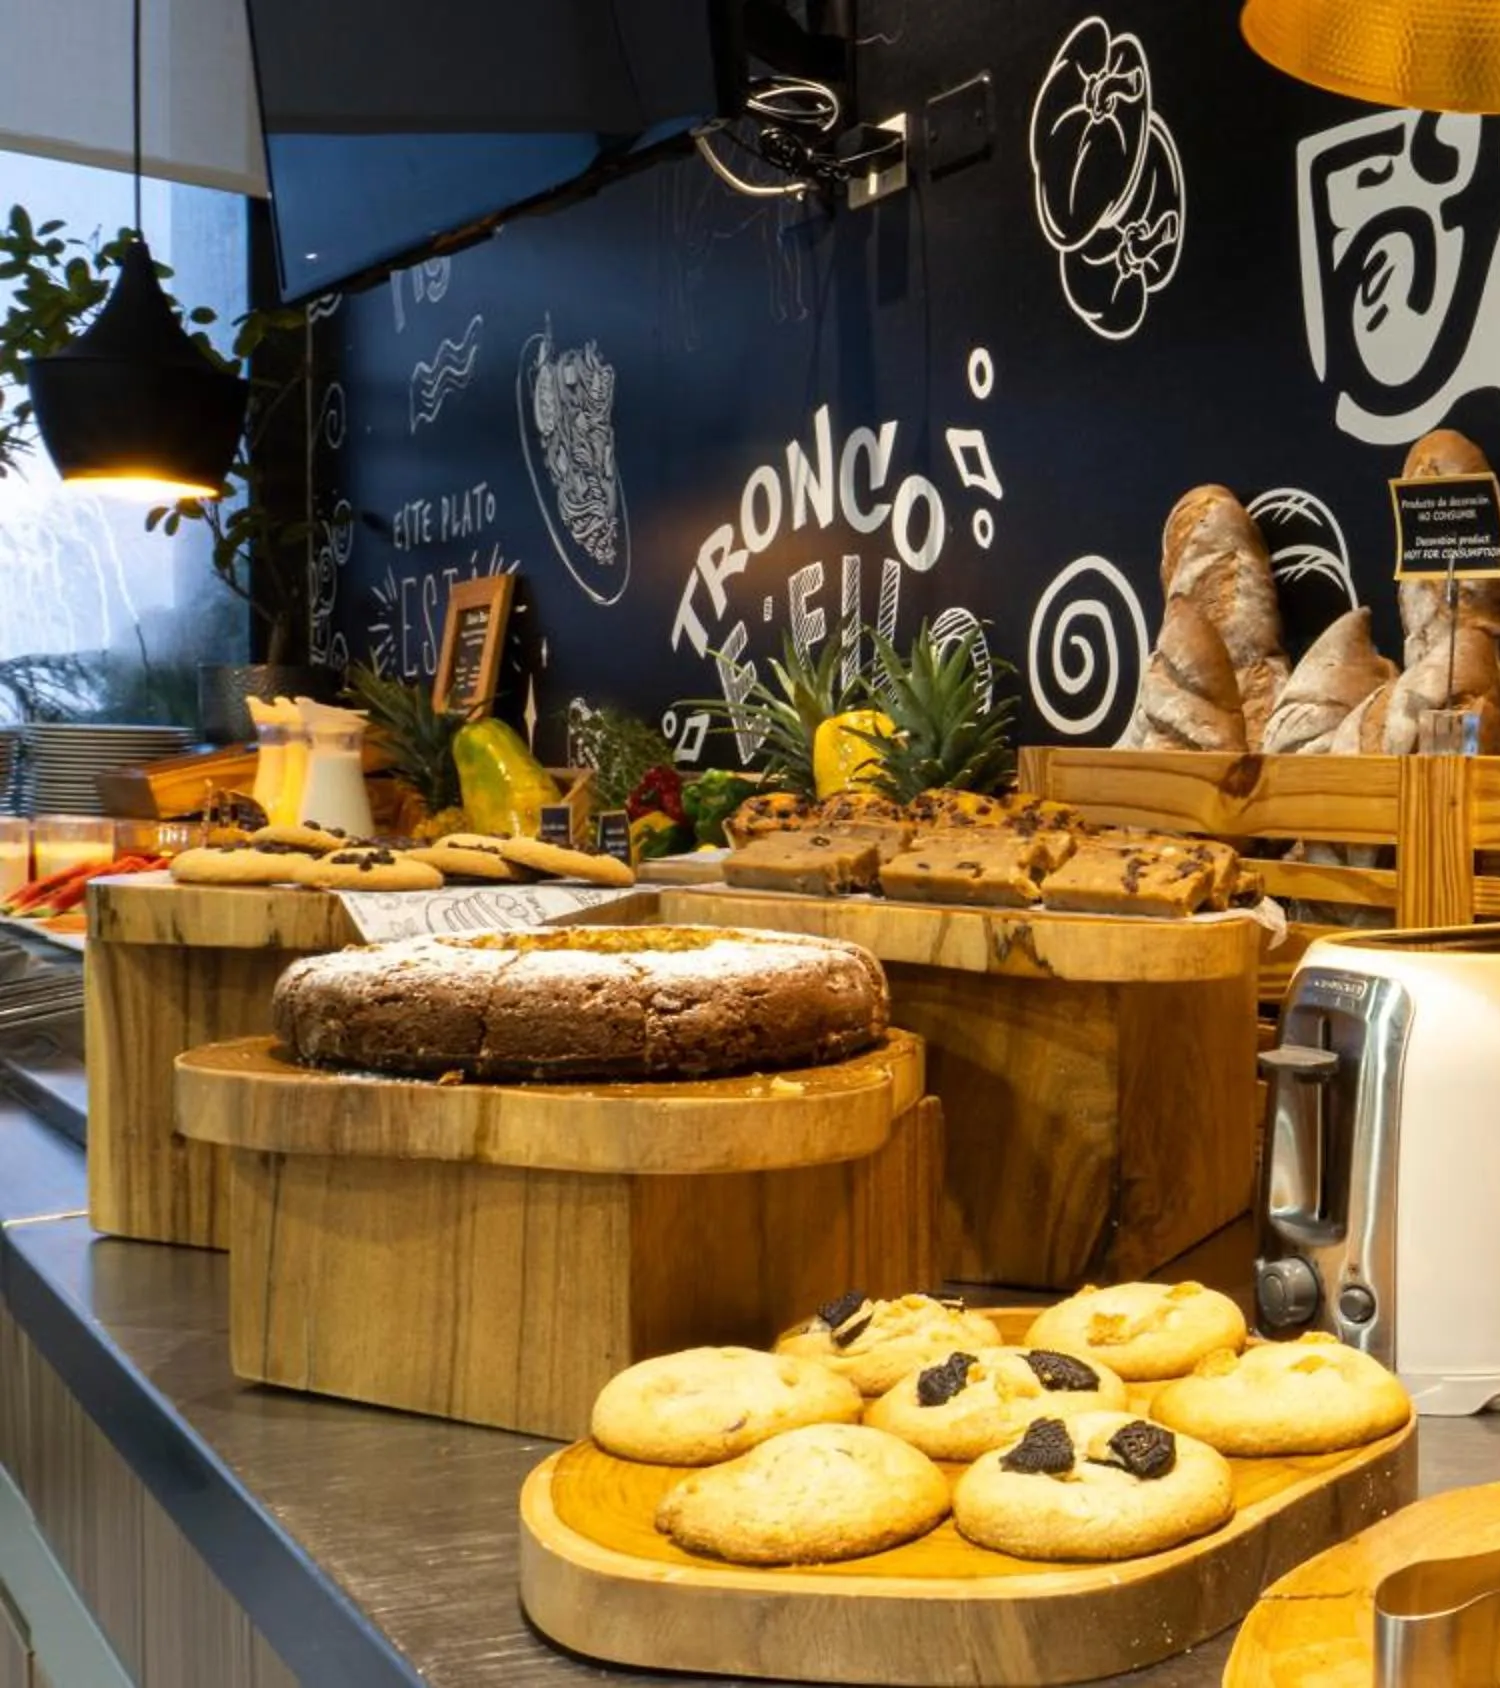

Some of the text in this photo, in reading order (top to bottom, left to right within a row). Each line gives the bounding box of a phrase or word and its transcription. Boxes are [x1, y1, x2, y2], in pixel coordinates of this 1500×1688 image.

[393, 481, 497, 551] ESTE PLATO
[1438, 496, 1447, 507] de
[671, 404, 946, 660] TRONCO
[1404, 549, 1421, 560] NOT
[1423, 549, 1440, 559] FOR
